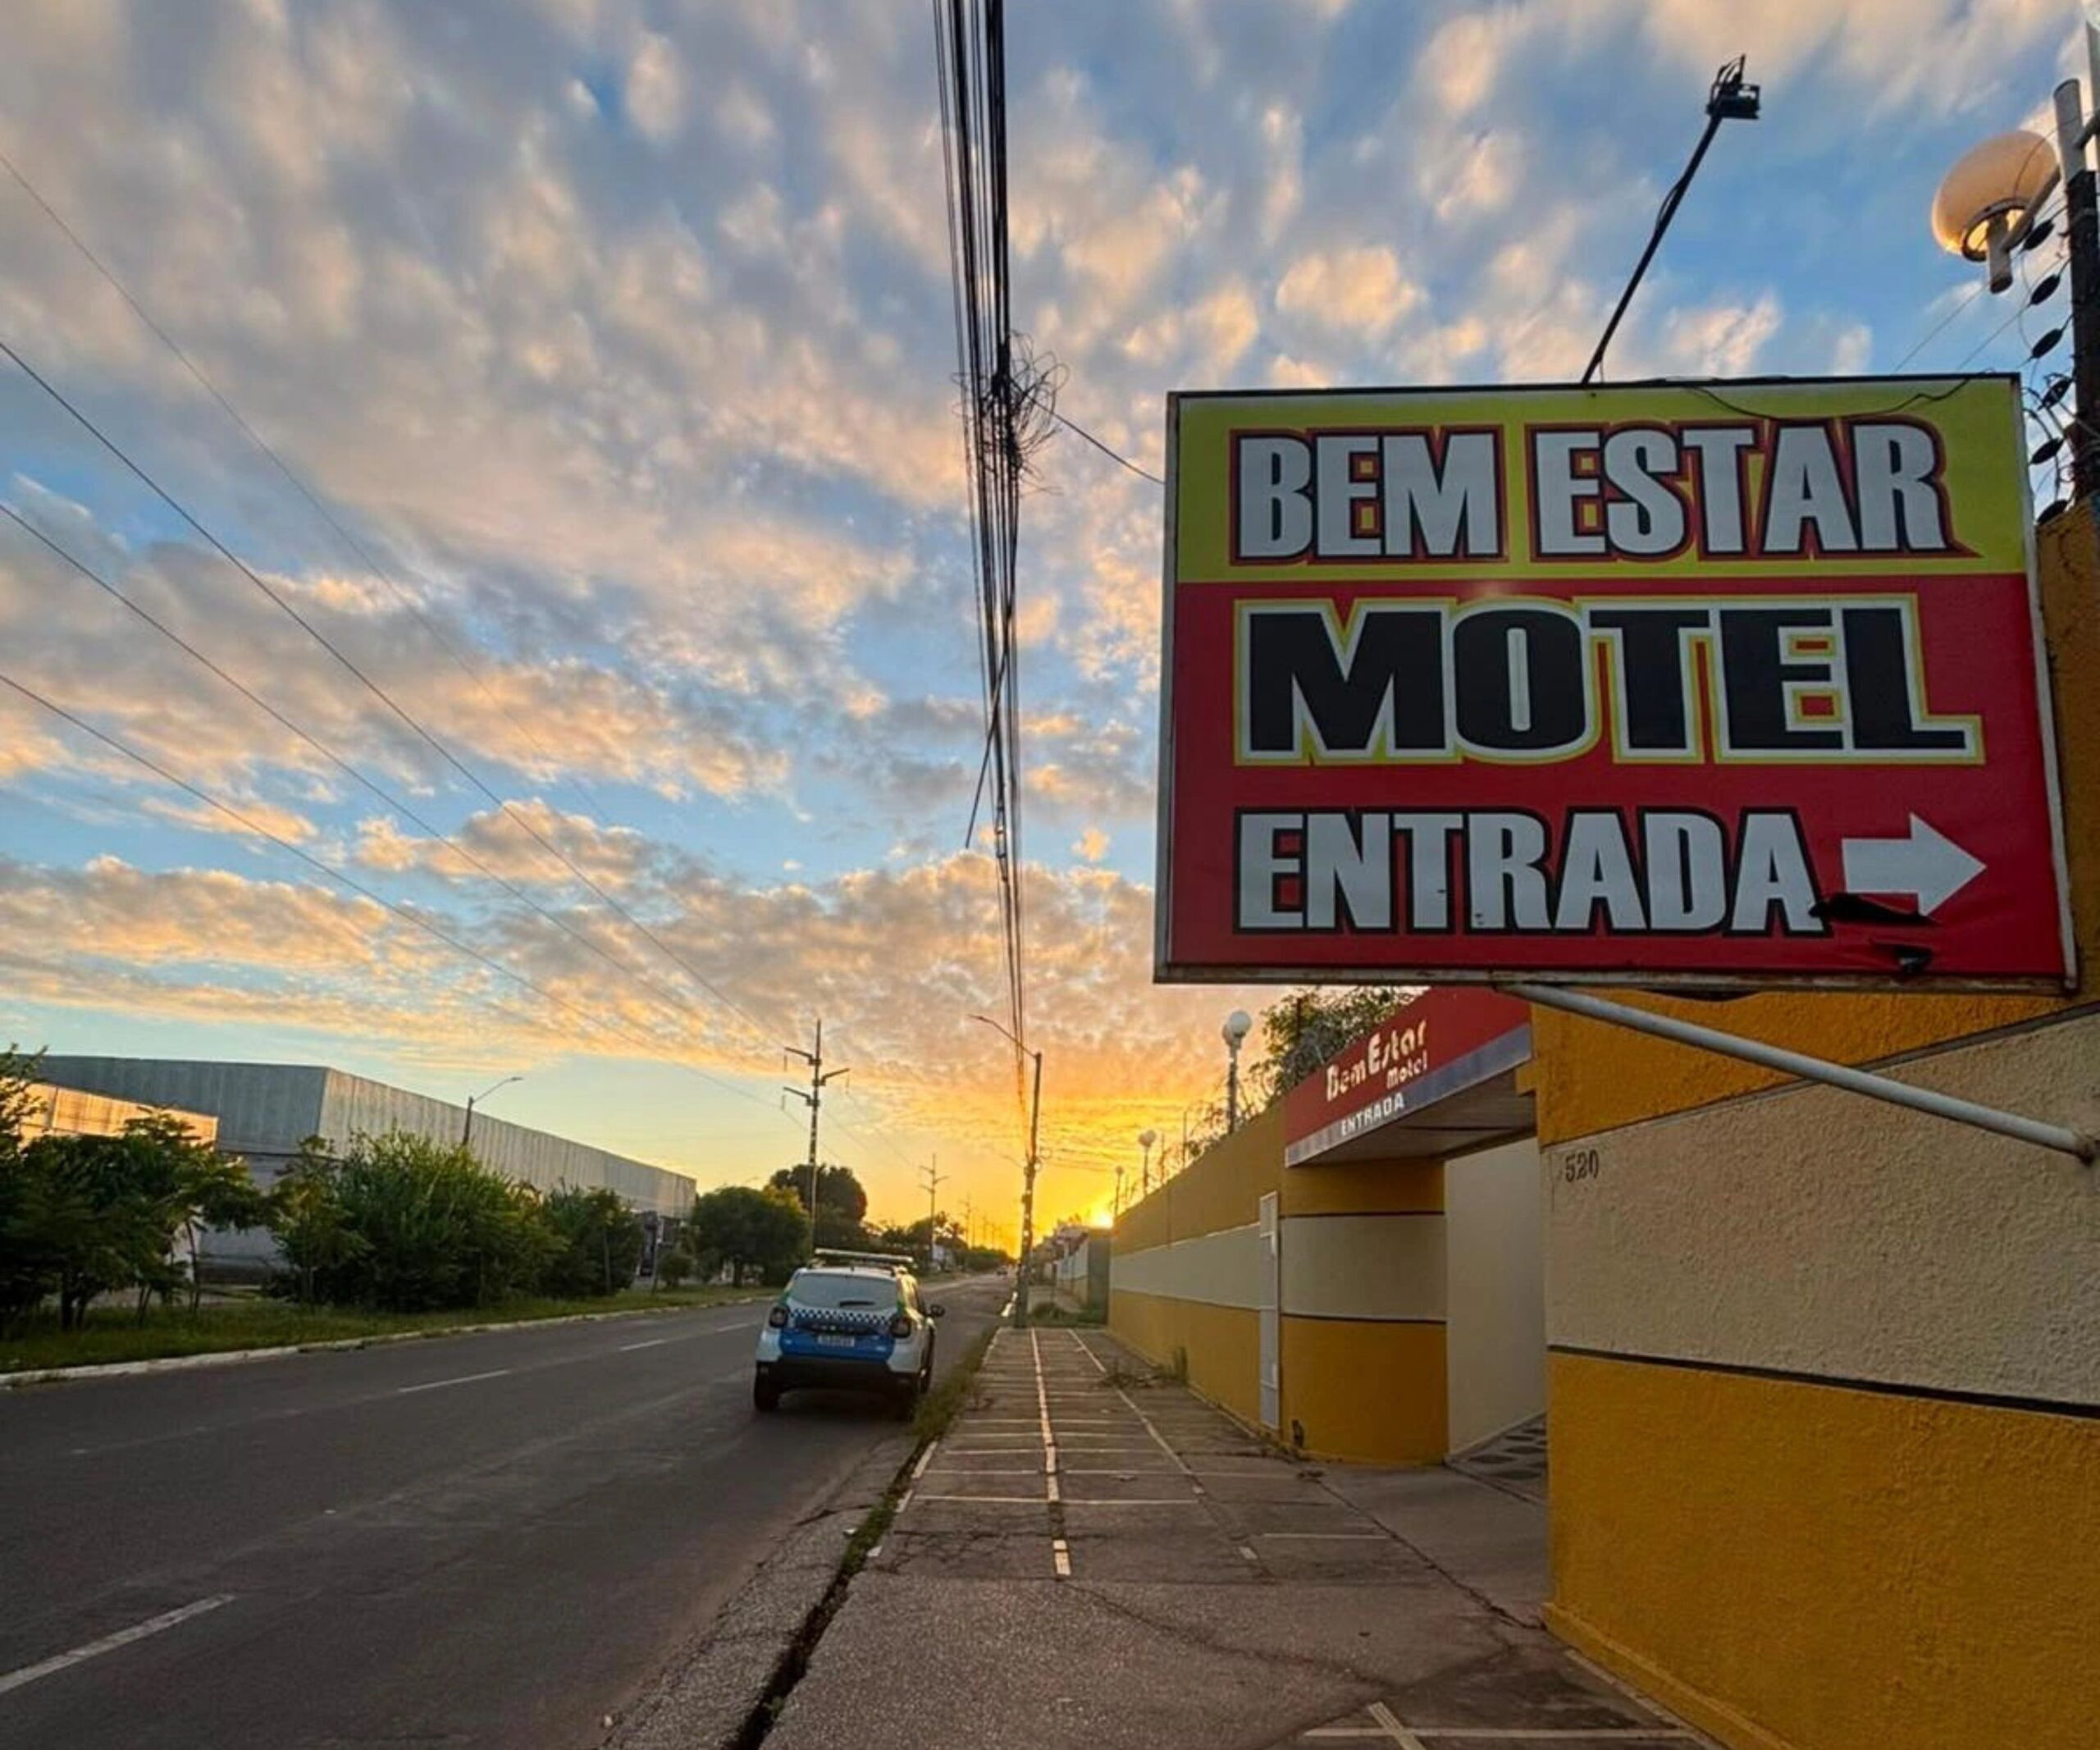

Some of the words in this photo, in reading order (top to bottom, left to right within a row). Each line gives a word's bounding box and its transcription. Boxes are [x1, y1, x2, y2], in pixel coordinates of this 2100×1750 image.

[1235, 427, 1504, 561] BEM
[1534, 420, 1952, 558] ESTAR
[1243, 601, 1974, 758] MOTEL
[1235, 810, 1827, 935] ENTRADA
[1340, 1092, 1405, 1136] ENTRADA
[1565, 1149, 1600, 1183] 520
